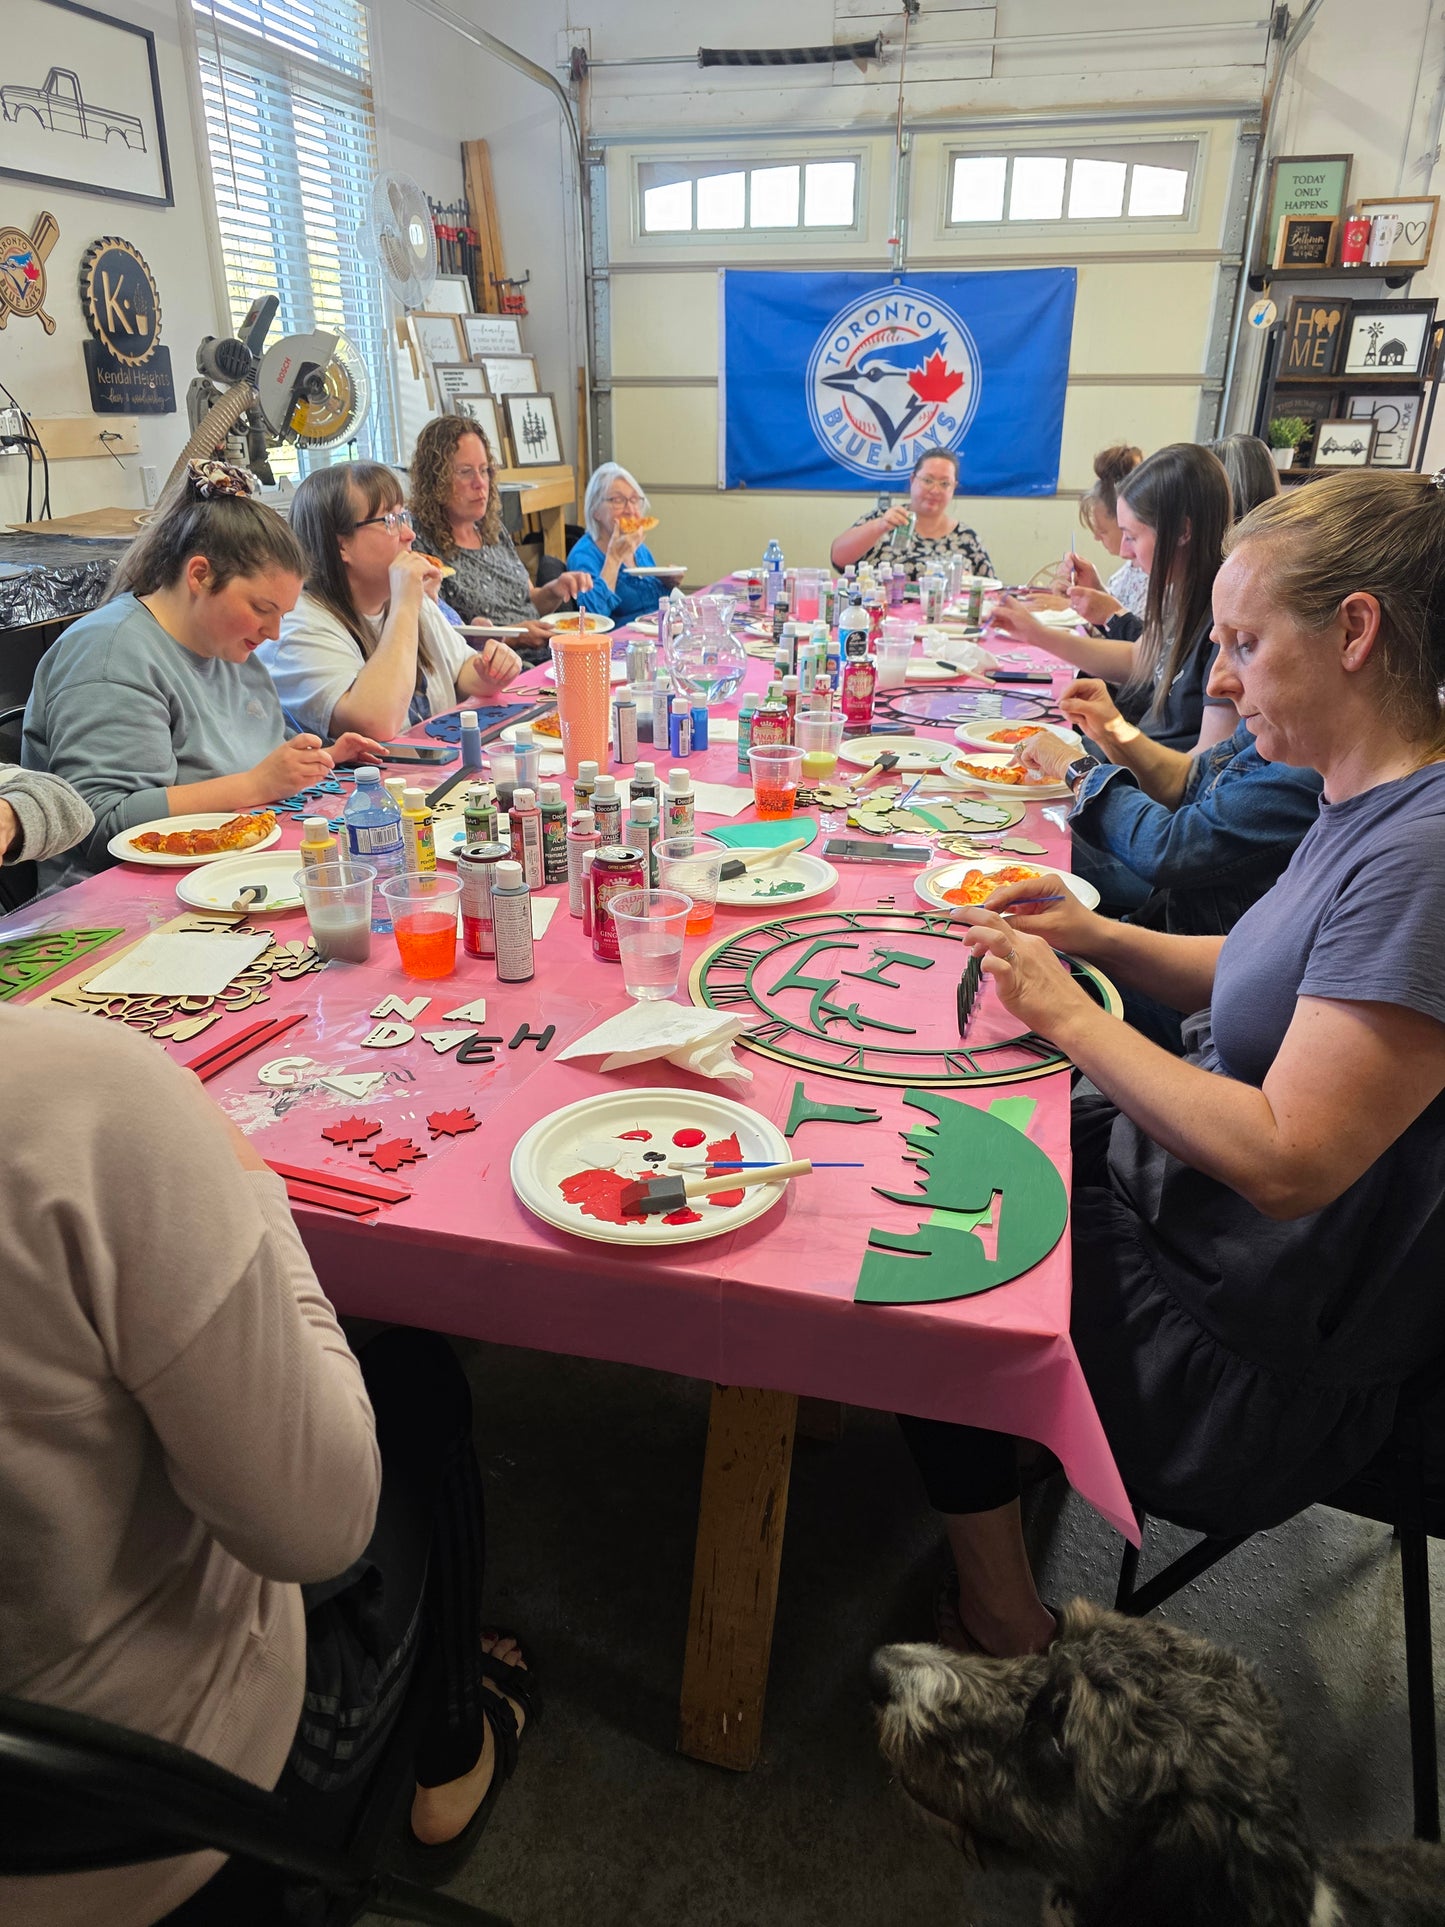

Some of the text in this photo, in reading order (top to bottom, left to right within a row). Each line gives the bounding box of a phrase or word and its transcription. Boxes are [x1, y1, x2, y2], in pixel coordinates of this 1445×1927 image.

[1292, 175, 1325, 185] TODAY
[1294, 188, 1321, 197] ONLY
[1284, 200, 1328, 210] HAPPENS
[0, 237, 28, 259] ORONTO
[25, 286, 41, 308] JAYS
[825, 302, 932, 367] TORONTO
[1289, 338, 1328, 367] ME
[97, 368, 171, 388] Kendal Heights
[276, 357, 292, 385] BOSCH
[1402, 402, 1414, 432] HOME
[823, 407, 957, 467] BLUE JAYS
[600, 930, 617, 938] GING
